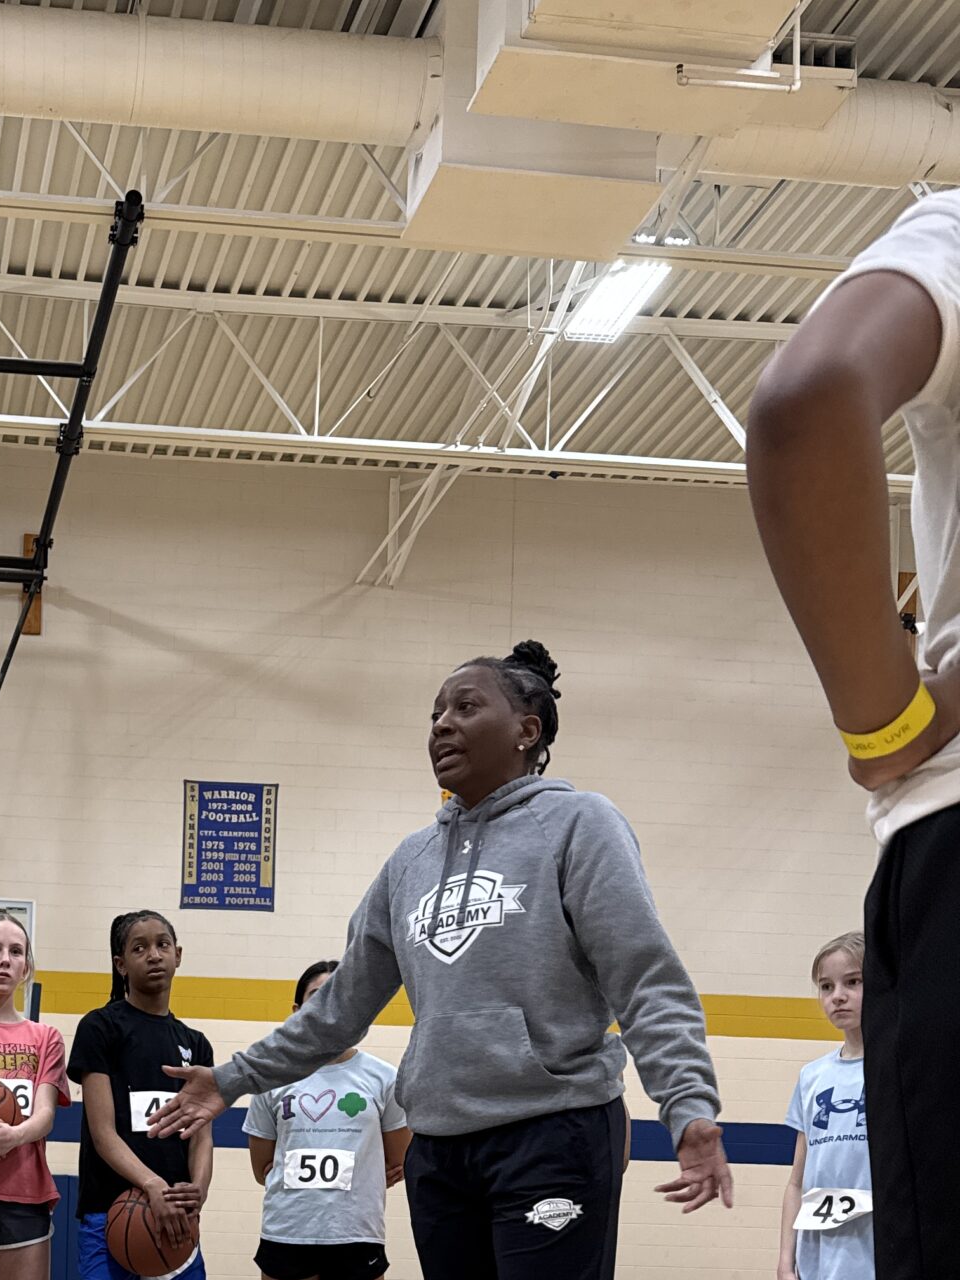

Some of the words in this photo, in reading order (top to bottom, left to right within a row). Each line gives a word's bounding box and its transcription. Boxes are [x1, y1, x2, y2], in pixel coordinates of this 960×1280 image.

[203, 790, 256, 802] WARRIOR
[208, 802, 253, 811] 1973-2008
[200, 810, 260, 823] FOOTBALL
[263, 788, 272, 862] BORROMEO
[201, 841, 225, 850] 1975
[233, 841, 257, 851] 1976
[201, 850, 225, 860] 1999
[201, 862, 224, 871] 2001
[233, 863, 257, 872] 2002
[200, 872, 224, 881] 2003
[233, 873, 256, 882] 2005
[224, 887, 257, 895] FAMILY
[225, 897, 272, 905] FOOTBALL
[419, 906, 492, 937] AADMY
[144, 1097, 172, 1119] 4
[808, 1135, 835, 1147] UNDER
[835, 1134, 869, 1143] ARMO
[298, 1155, 339, 1183] 50
[813, 1195, 856, 1224] 43
[538, 1211, 573, 1221] ACADEMY
